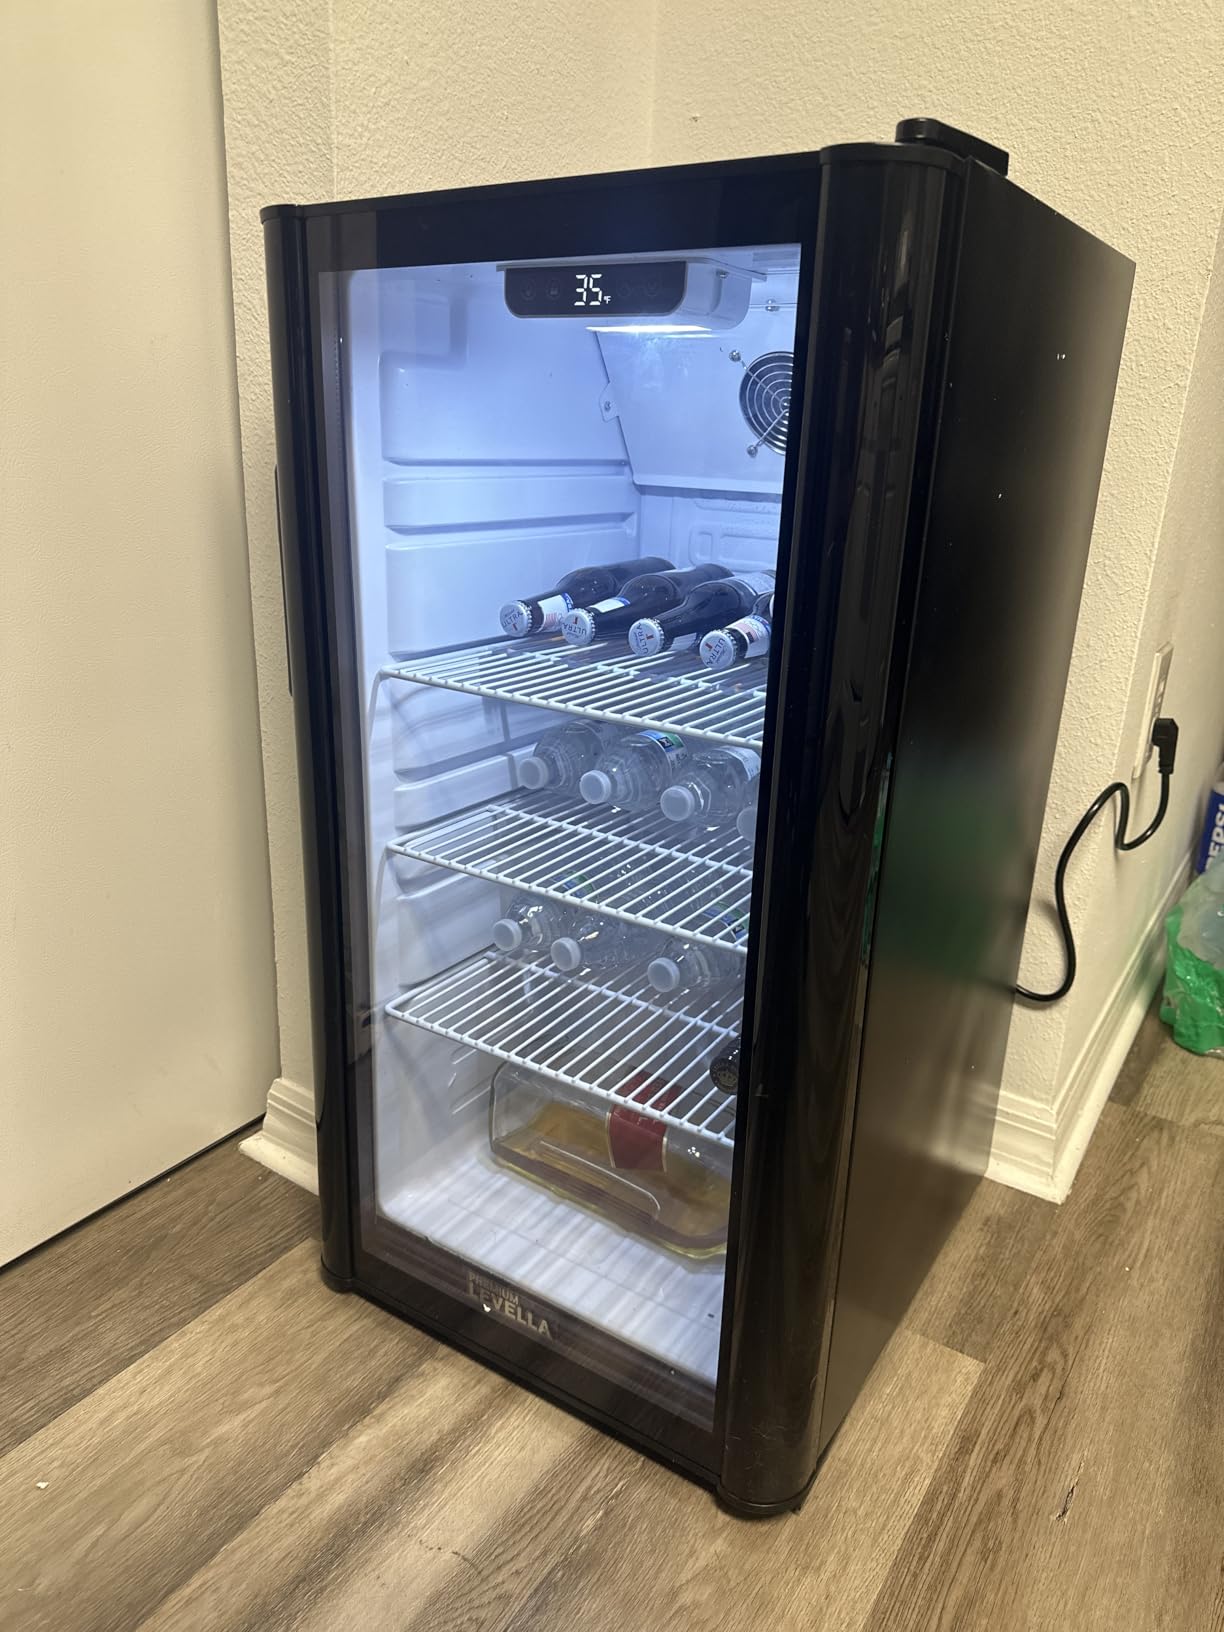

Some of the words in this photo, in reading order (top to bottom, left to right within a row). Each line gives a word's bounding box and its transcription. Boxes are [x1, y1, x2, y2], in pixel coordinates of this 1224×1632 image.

[502, 611, 523, 628] ULTRA
[562, 622, 587, 635] ULTRA
[637, 621, 649, 654] ULTRA
[706, 638, 724, 664] ULTRA
[468, 1281, 553, 1341] LEVELLA
